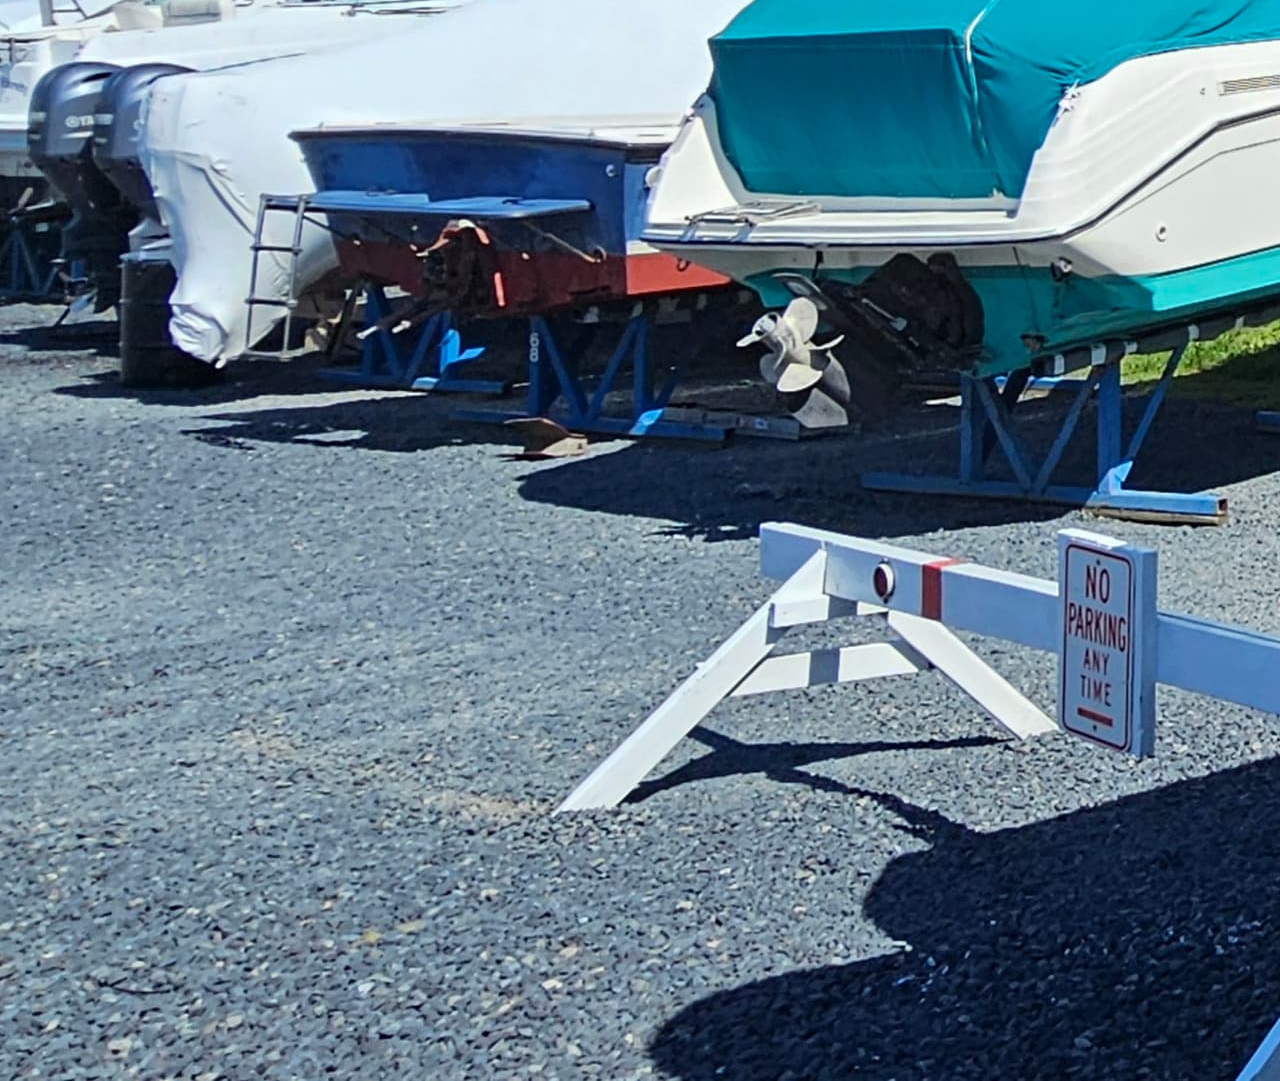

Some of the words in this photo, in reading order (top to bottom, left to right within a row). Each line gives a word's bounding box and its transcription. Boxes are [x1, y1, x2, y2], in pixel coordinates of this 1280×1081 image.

[1085, 565, 1110, 603] NO
[1068, 602, 1127, 653] PARKING
[1082, 649, 1110, 677] ANY
[1080, 675, 1112, 707] TIME
